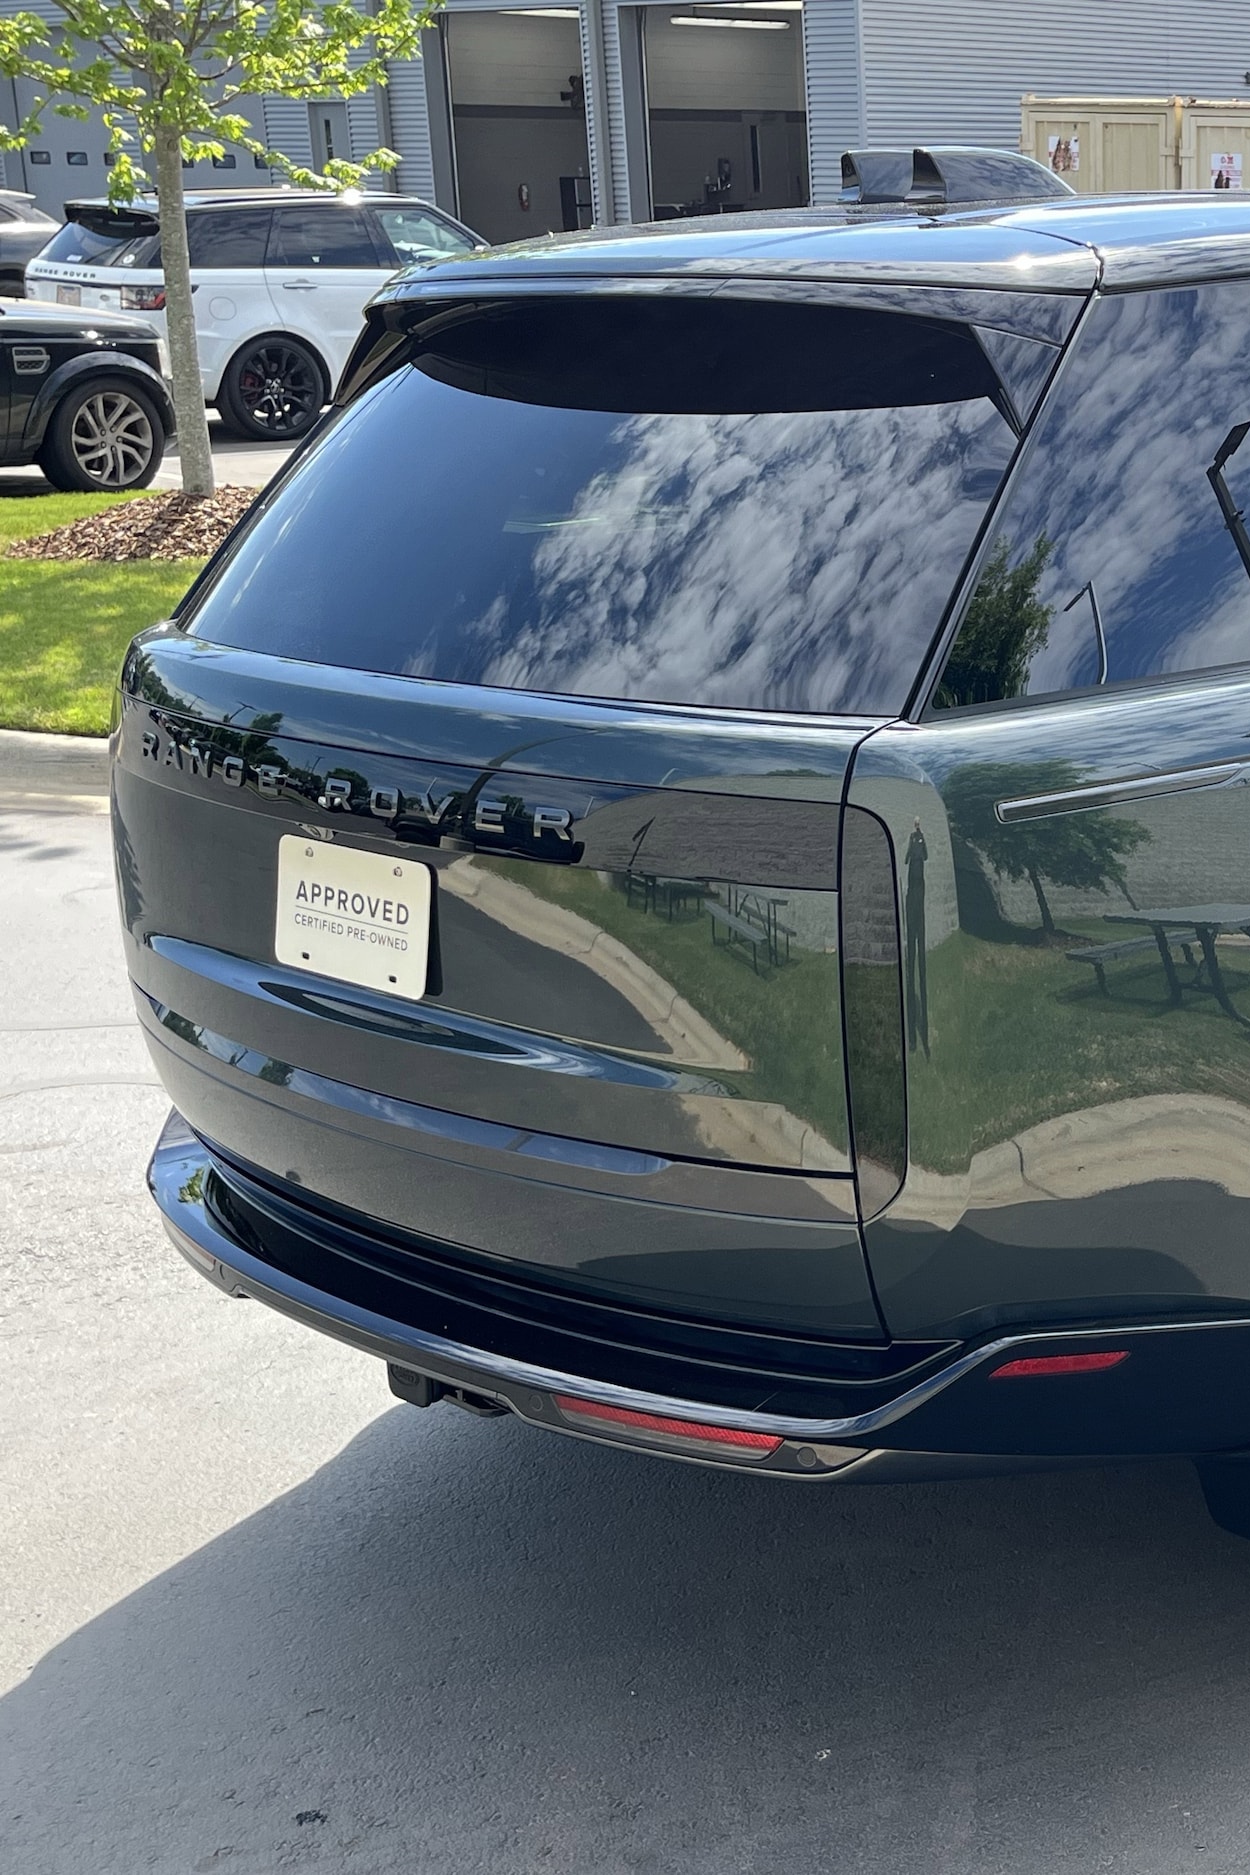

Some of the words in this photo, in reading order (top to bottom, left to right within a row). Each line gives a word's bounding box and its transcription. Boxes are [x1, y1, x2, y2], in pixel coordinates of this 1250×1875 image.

[63, 269, 96, 278] ROVER
[141, 730, 283, 797] RANGE
[323, 778, 573, 841] ROVER
[296, 880, 409, 925] APPROVED
[295, 913, 344, 935] CERTIFIED
[347, 926, 408, 952] PRE-OWNED
